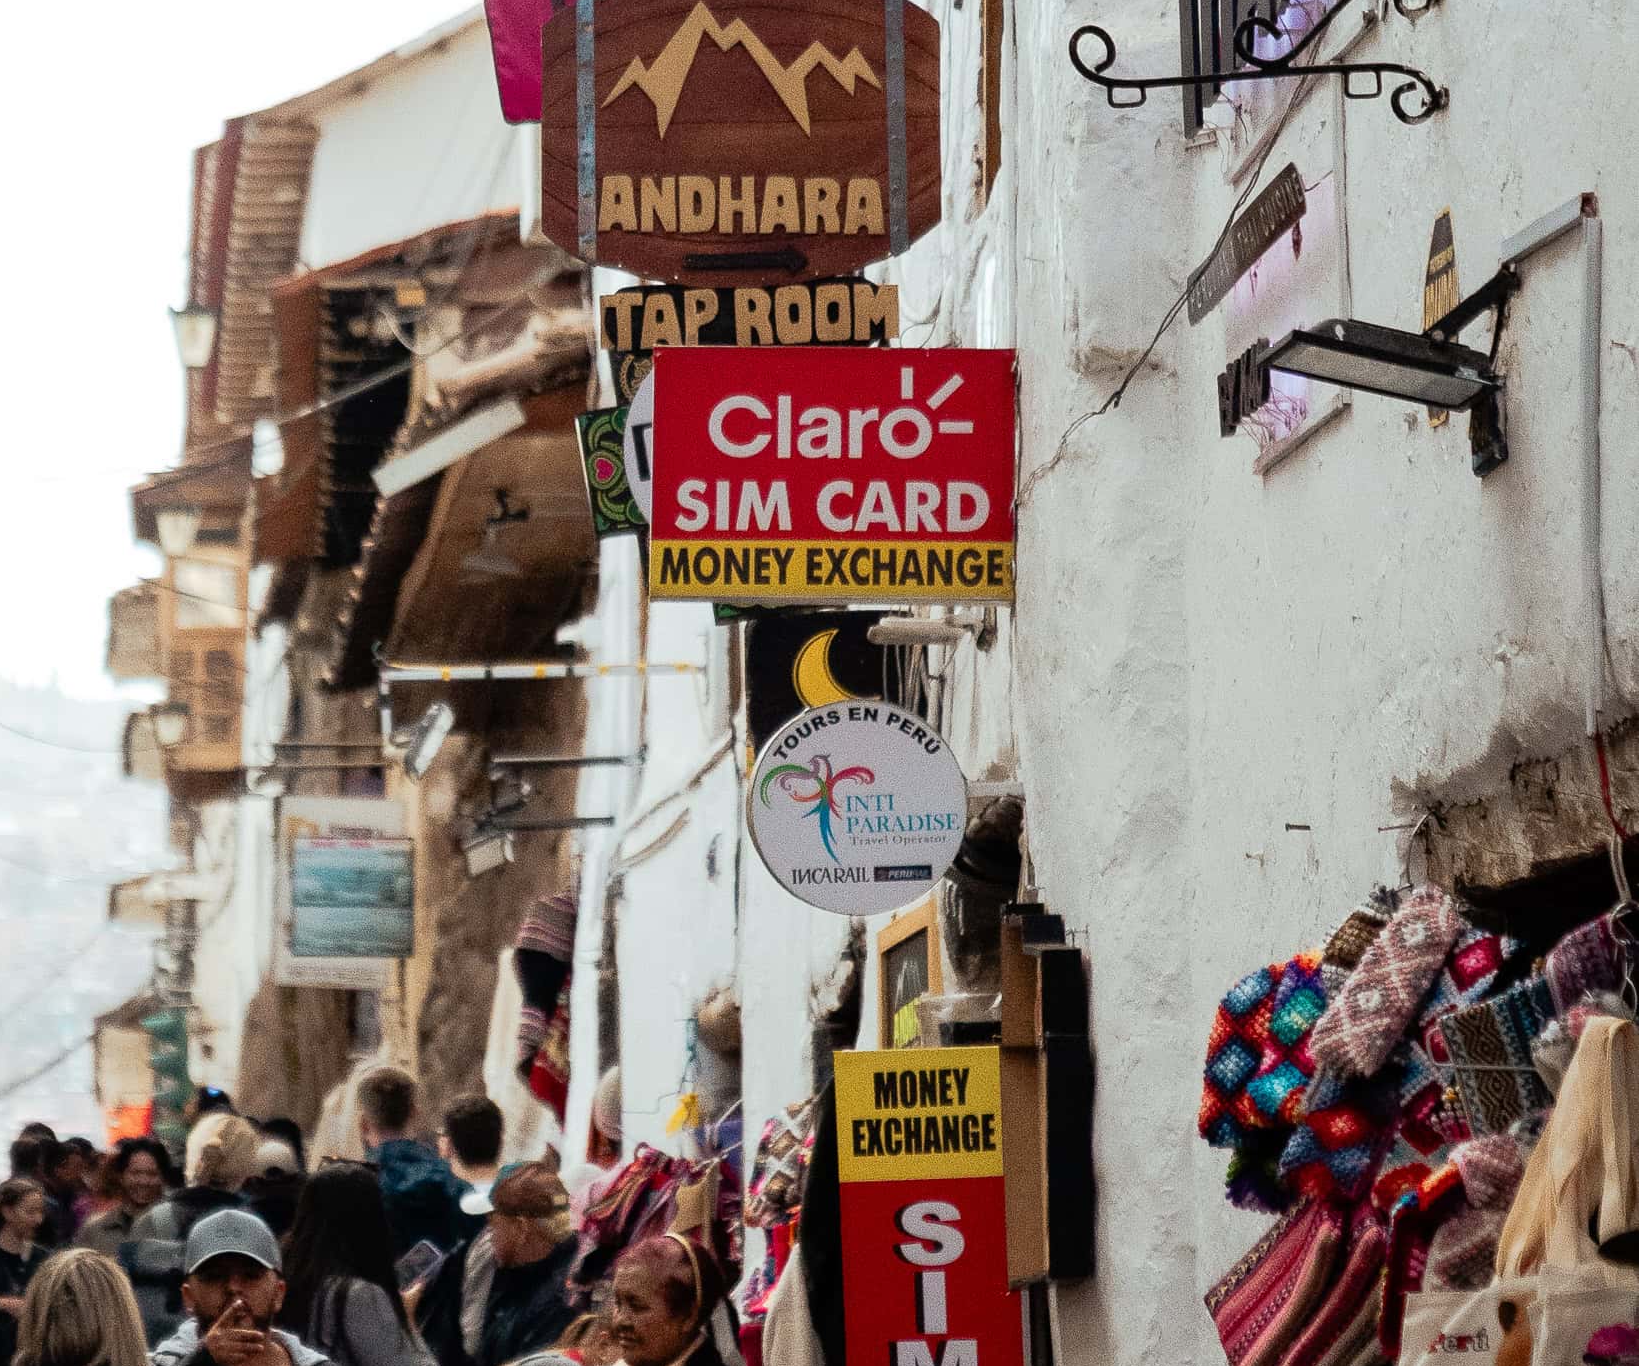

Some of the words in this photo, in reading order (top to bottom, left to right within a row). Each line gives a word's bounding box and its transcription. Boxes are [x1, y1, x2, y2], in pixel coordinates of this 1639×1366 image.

[598, 176, 887, 235] ANDHARA
[604, 289, 719, 351] TAP
[734, 283, 900, 347] ROOM
[708, 392, 934, 460] Claro
[674, 480, 793, 533] SIM
[816, 480, 990, 533] CARD
[659, 547, 794, 586] MONEY
[806, 547, 1005, 586] EXCHANGE
[773, 711, 841, 762] TOURS
[849, 707, 879, 722] EN
[886, 712, 942, 756] PERÚ
[846, 793, 894, 813] INTI
[846, 812, 960, 835] PARADISE
[850, 836, 890, 846] Travel
[892, 835, 950, 846] Operator
[872, 1068, 970, 1110] MONEY
[852, 1112, 998, 1157] EXCHANGE
